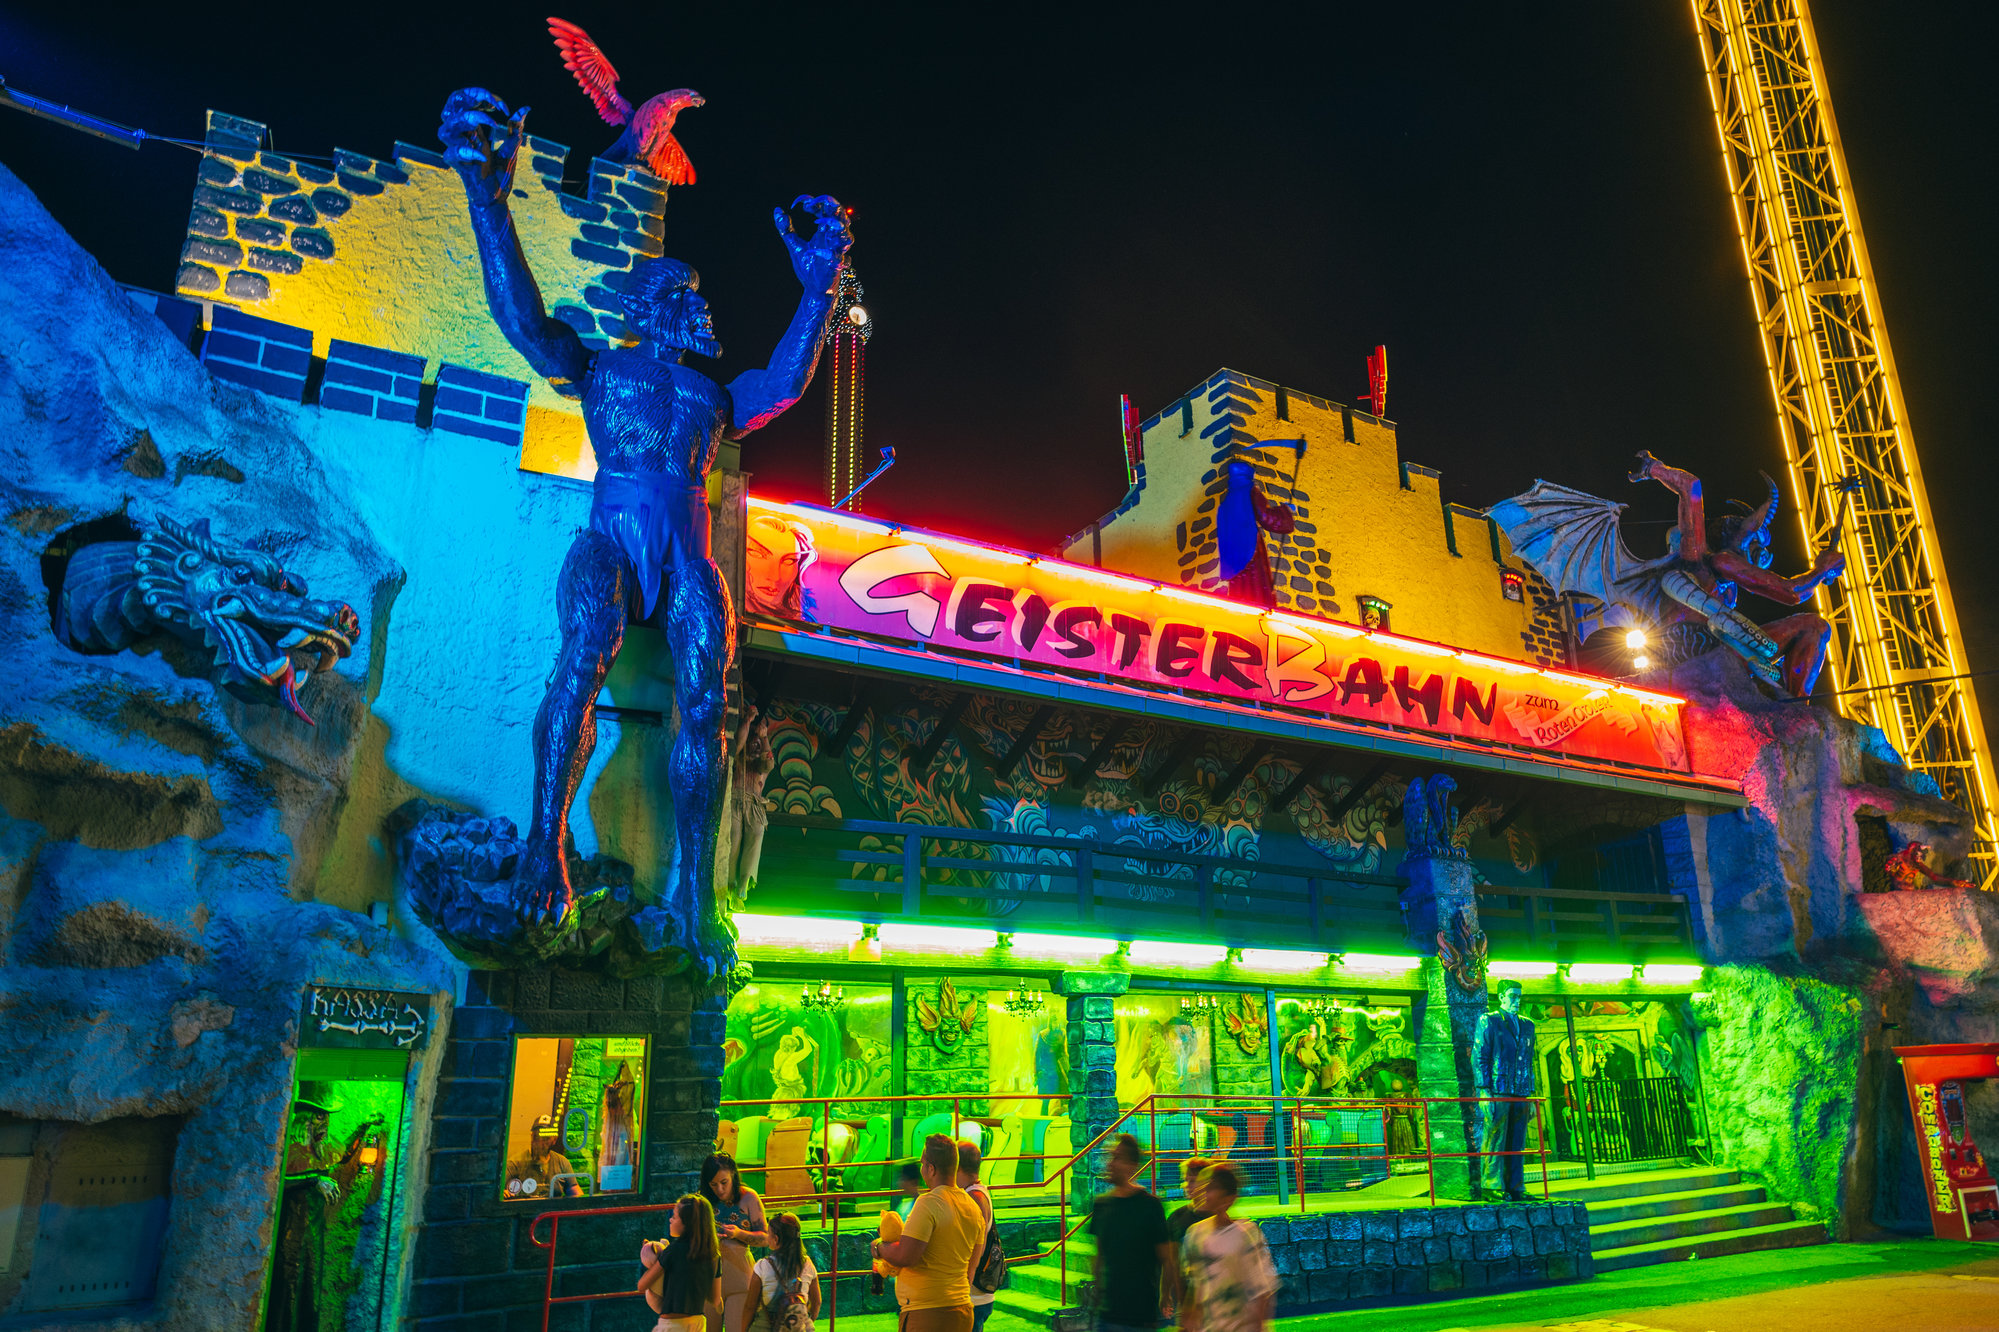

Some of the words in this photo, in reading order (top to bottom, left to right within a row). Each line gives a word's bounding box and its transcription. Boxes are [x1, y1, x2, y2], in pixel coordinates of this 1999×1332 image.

[1534, 716, 1578, 744] Roten
[1573, 695, 1614, 722] Adler
[310, 987, 399, 1020] KASSA
